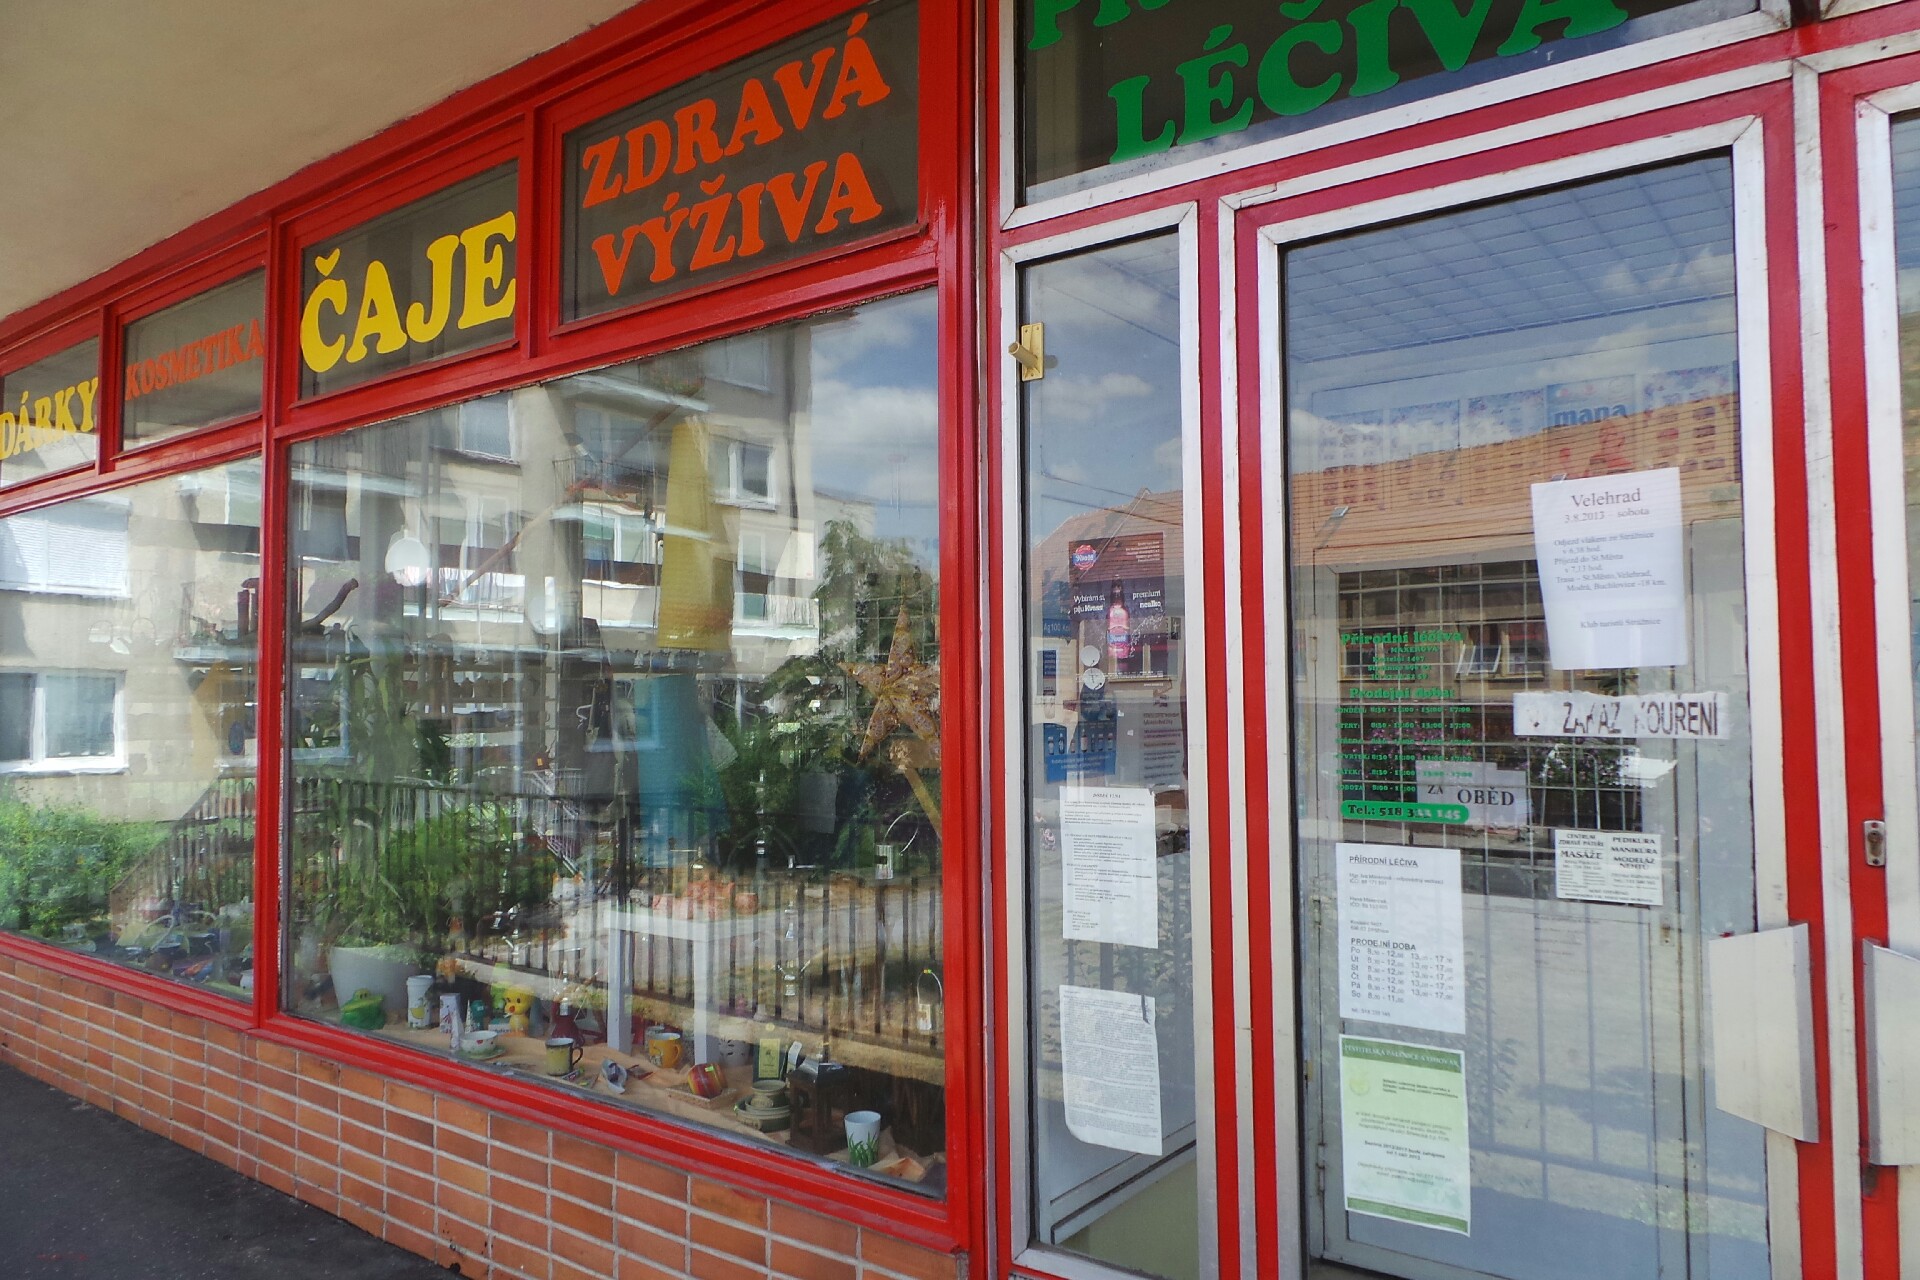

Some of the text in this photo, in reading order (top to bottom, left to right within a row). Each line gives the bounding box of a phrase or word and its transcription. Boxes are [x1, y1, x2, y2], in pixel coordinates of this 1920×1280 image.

[582, 12, 891, 208] ZDRAVÁ
[592, 152, 882, 296] VÝŽIVA
[301, 211, 517, 373] ČAJE
[126, 319, 264, 401] KOSMETIKA
[0, 376, 98, 461] DÁRKY
[1554, 404, 1627, 427] mana
[1571, 488, 1641, 508] Velehrad
[1618, 508, 1650, 518] sobota
[1133, 590, 1160, 600] premium
[1341, 630, 1463, 645] Přírodní léčiva
[1350, 688, 1410, 700] Prodejní
[1428, 785, 1515, 806] ZA OBĚD
[1348, 805, 1375, 815] Tel.:
[1380, 807, 1402, 816] 518
[1349, 854, 1387, 865] PŘÍRODNÍ
[1560, 849, 1603, 860] MASÁŽE
[1351, 937, 1416, 950] PRODEJNÍ DOBA
